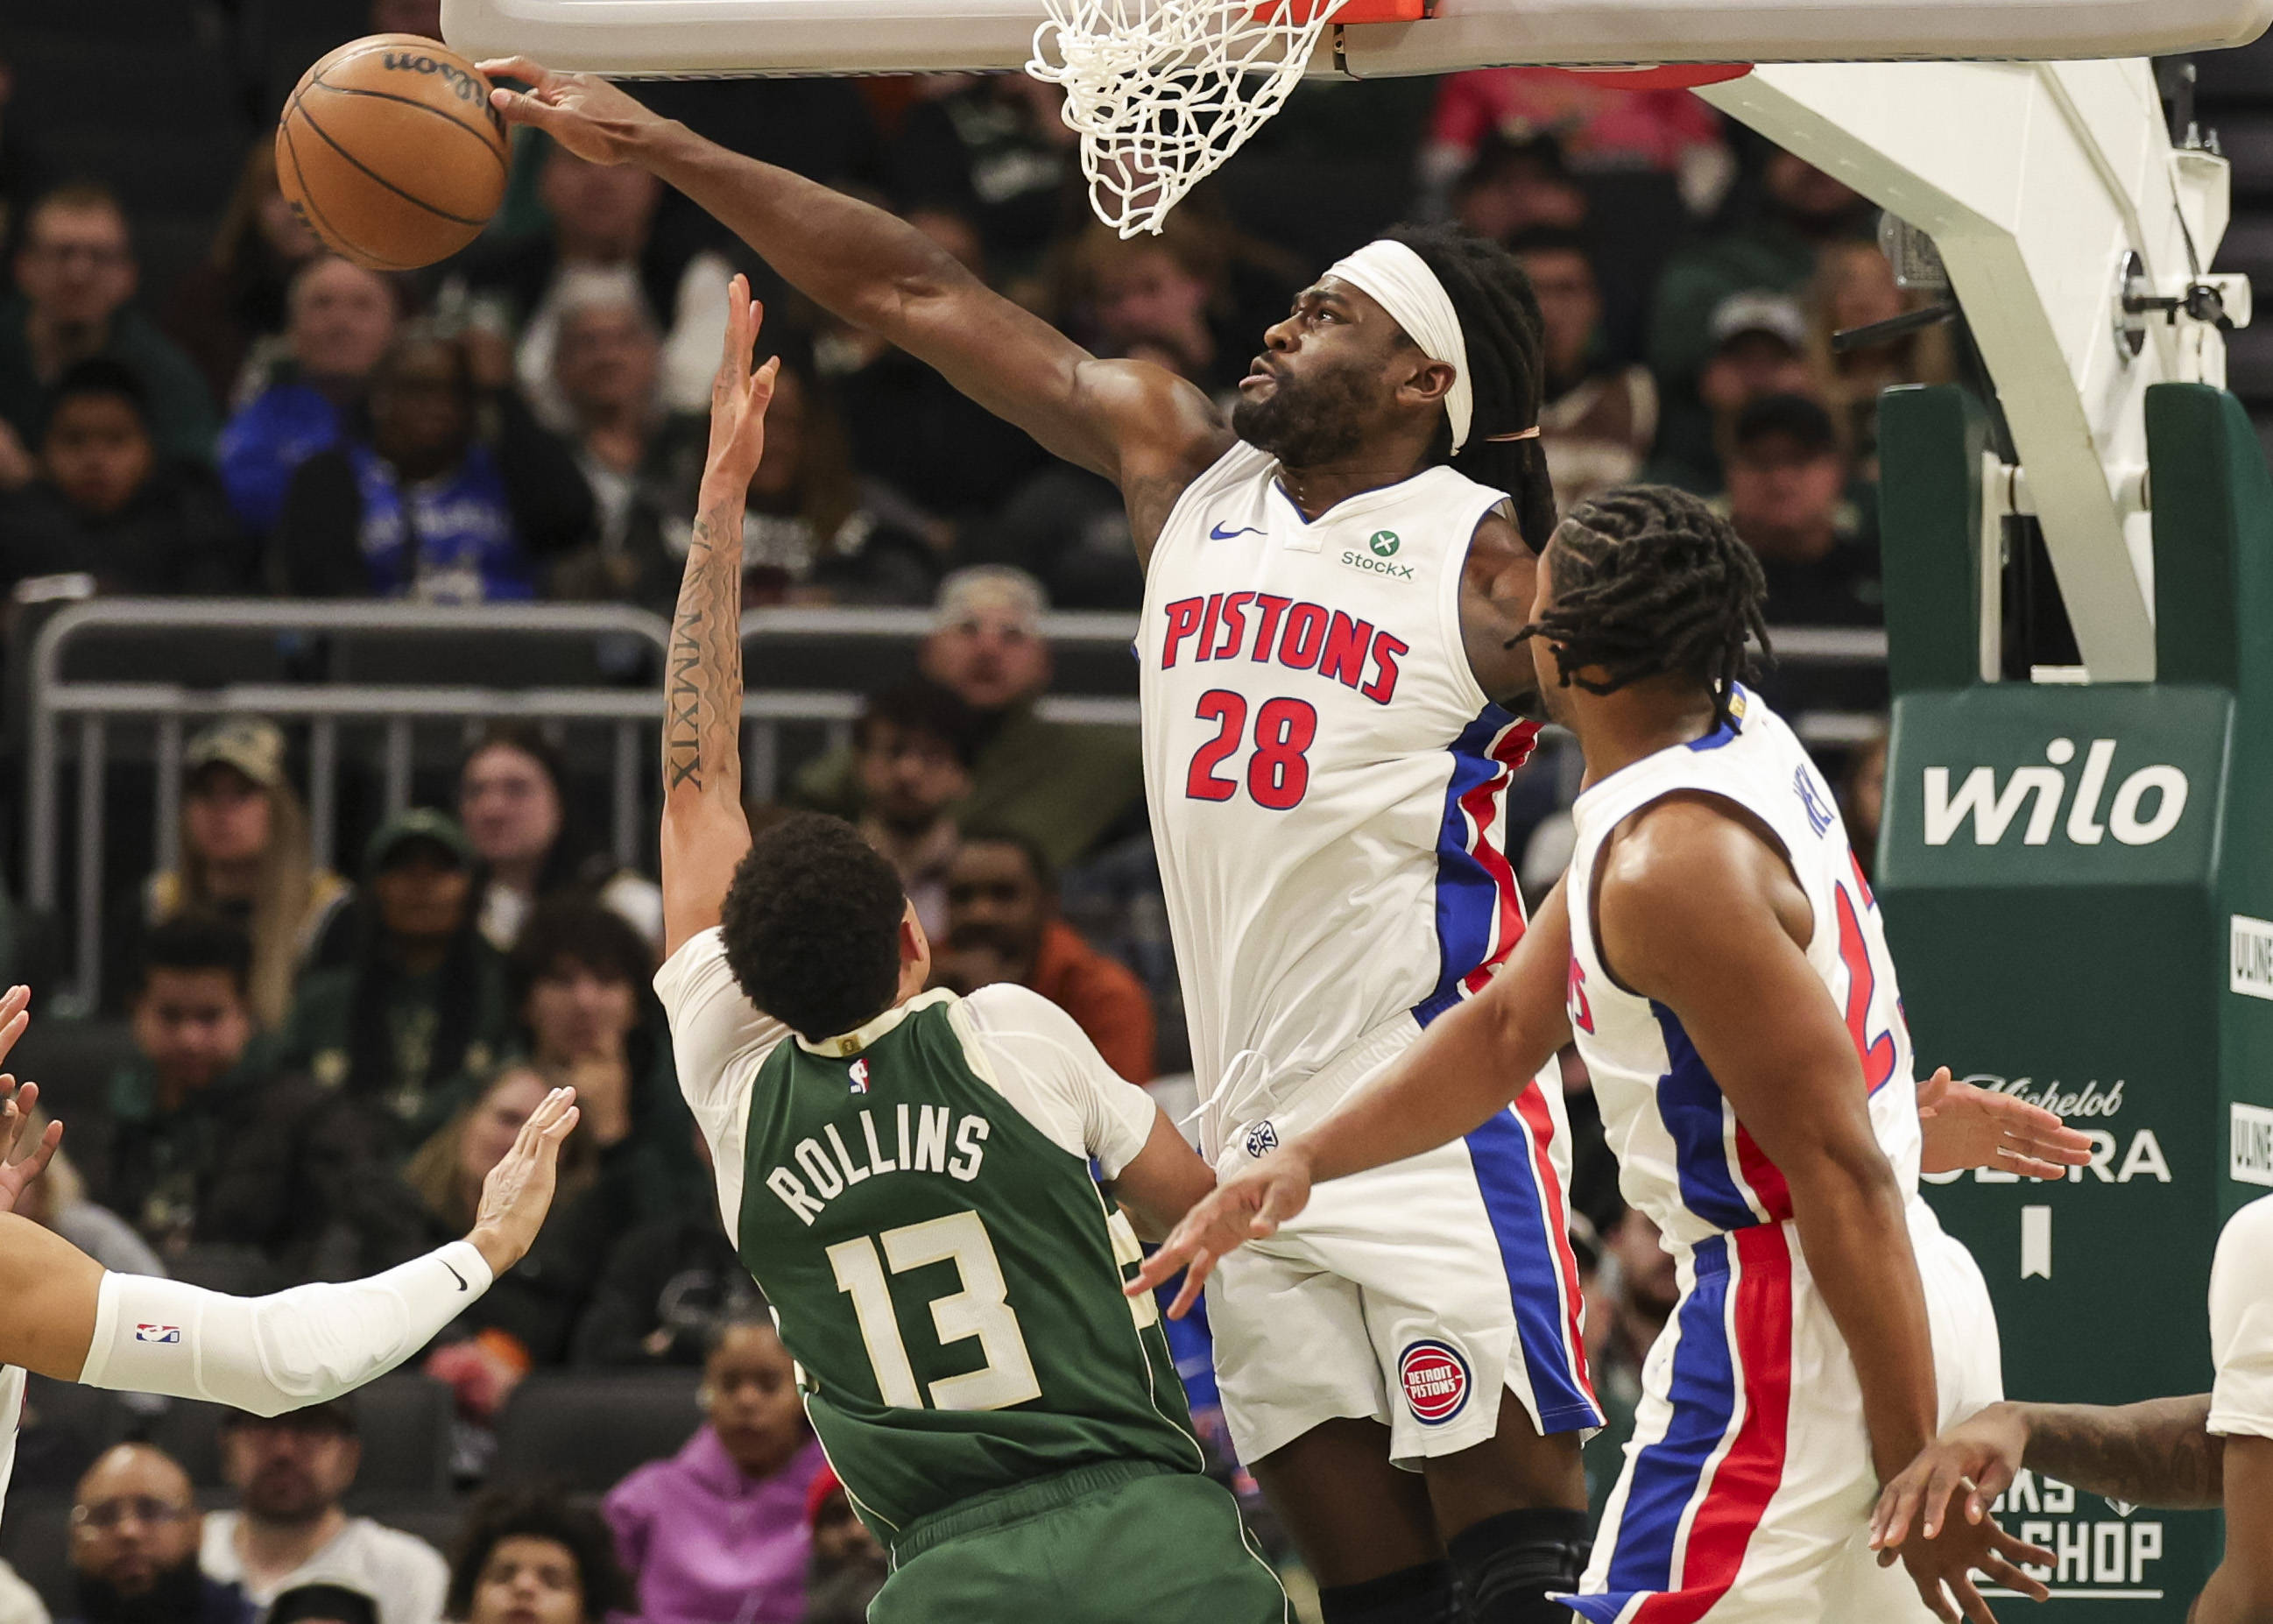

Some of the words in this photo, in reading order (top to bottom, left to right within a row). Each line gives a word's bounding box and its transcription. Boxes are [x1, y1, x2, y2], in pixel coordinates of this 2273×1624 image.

[1341, 551, 1415, 580] StockX
[1161, 591, 1409, 706] PISTONS
[1185, 688, 1317, 811] 28
[1924, 737, 2189, 845] wilo
[766, 1104, 990, 1226] ROLLINS
[825, 1210, 1042, 1411] 13
[1407, 1365, 1451, 1384] DETROIT
[1409, 1379, 1457, 1399] PISTONS
[2020, 1521, 2163, 1583] SHOP
